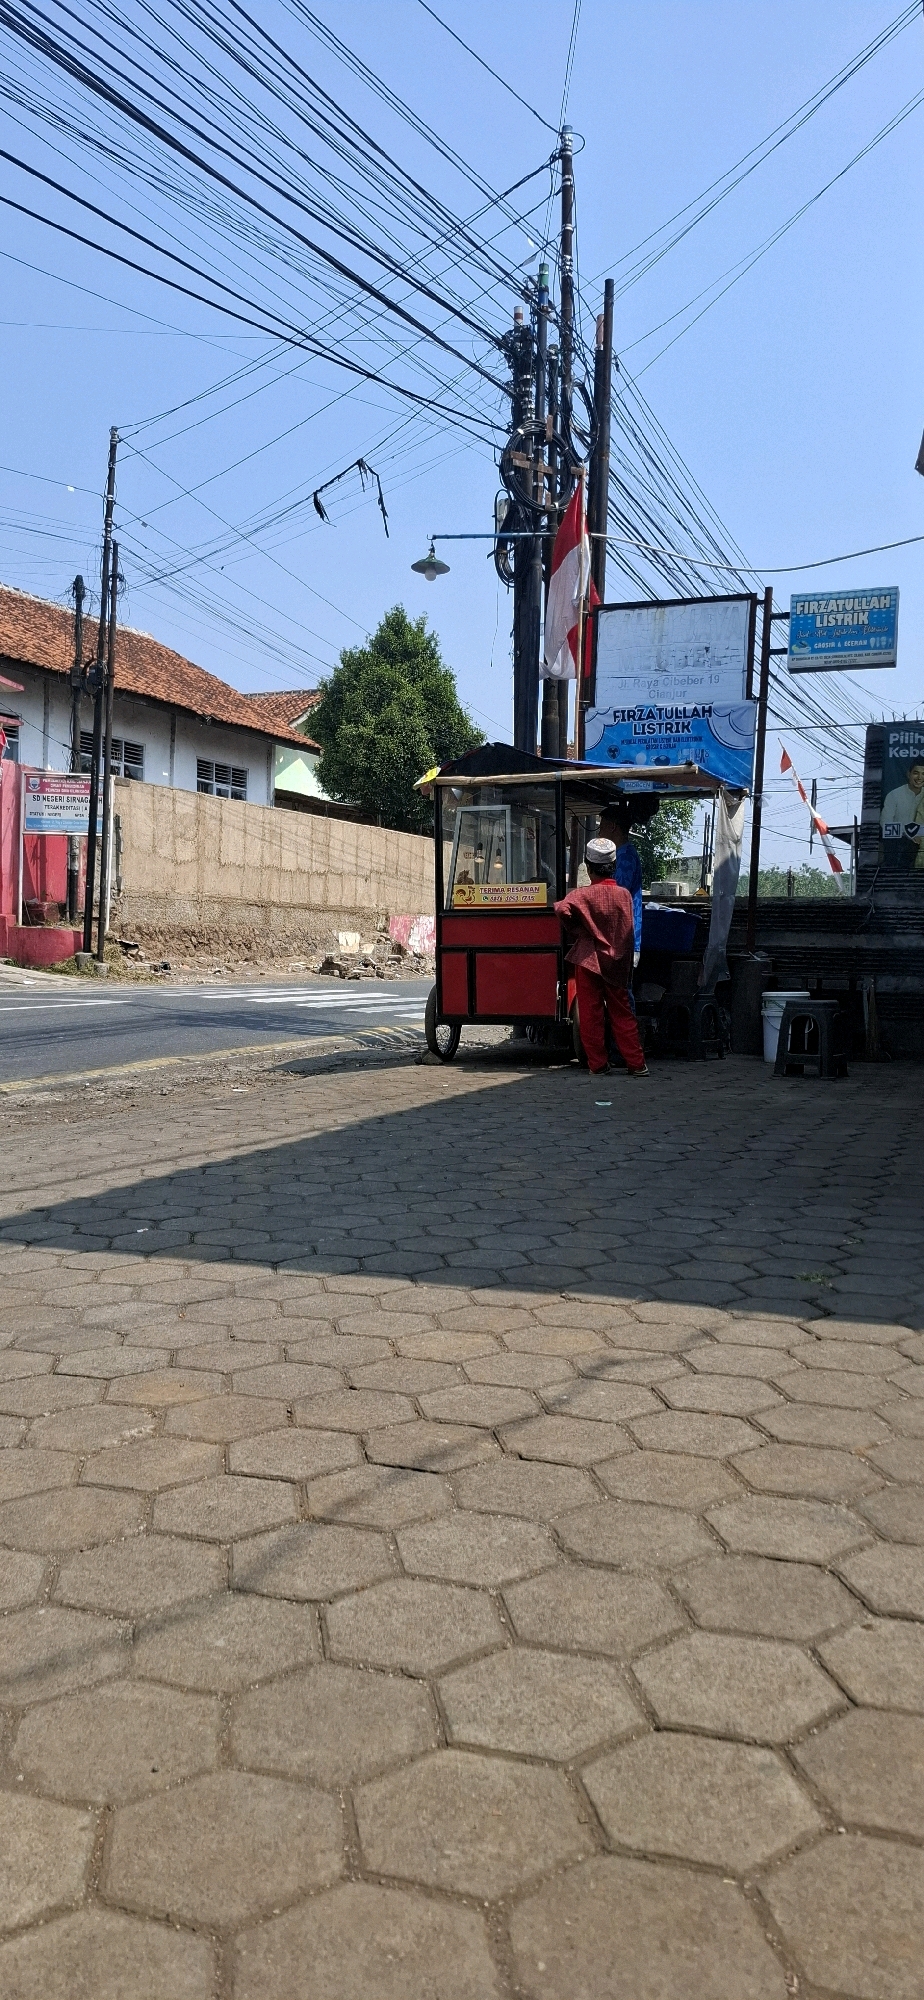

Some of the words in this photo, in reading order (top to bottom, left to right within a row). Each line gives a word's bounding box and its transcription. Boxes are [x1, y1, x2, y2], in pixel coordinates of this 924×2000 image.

[796, 595, 891, 615] FIRZATULLAH
[815, 611, 870, 628] LISTRIK
[633, 677, 660, 690] Raya
[662, 674, 704, 687] Cibeber
[708, 674, 720, 684] 19
[648, 689, 687, 701] Cianjur
[613, 705, 712, 722] FIRZATULLAH
[633, 722, 692, 736] LISTRIK
[42, 795, 65, 803] NEGERI
